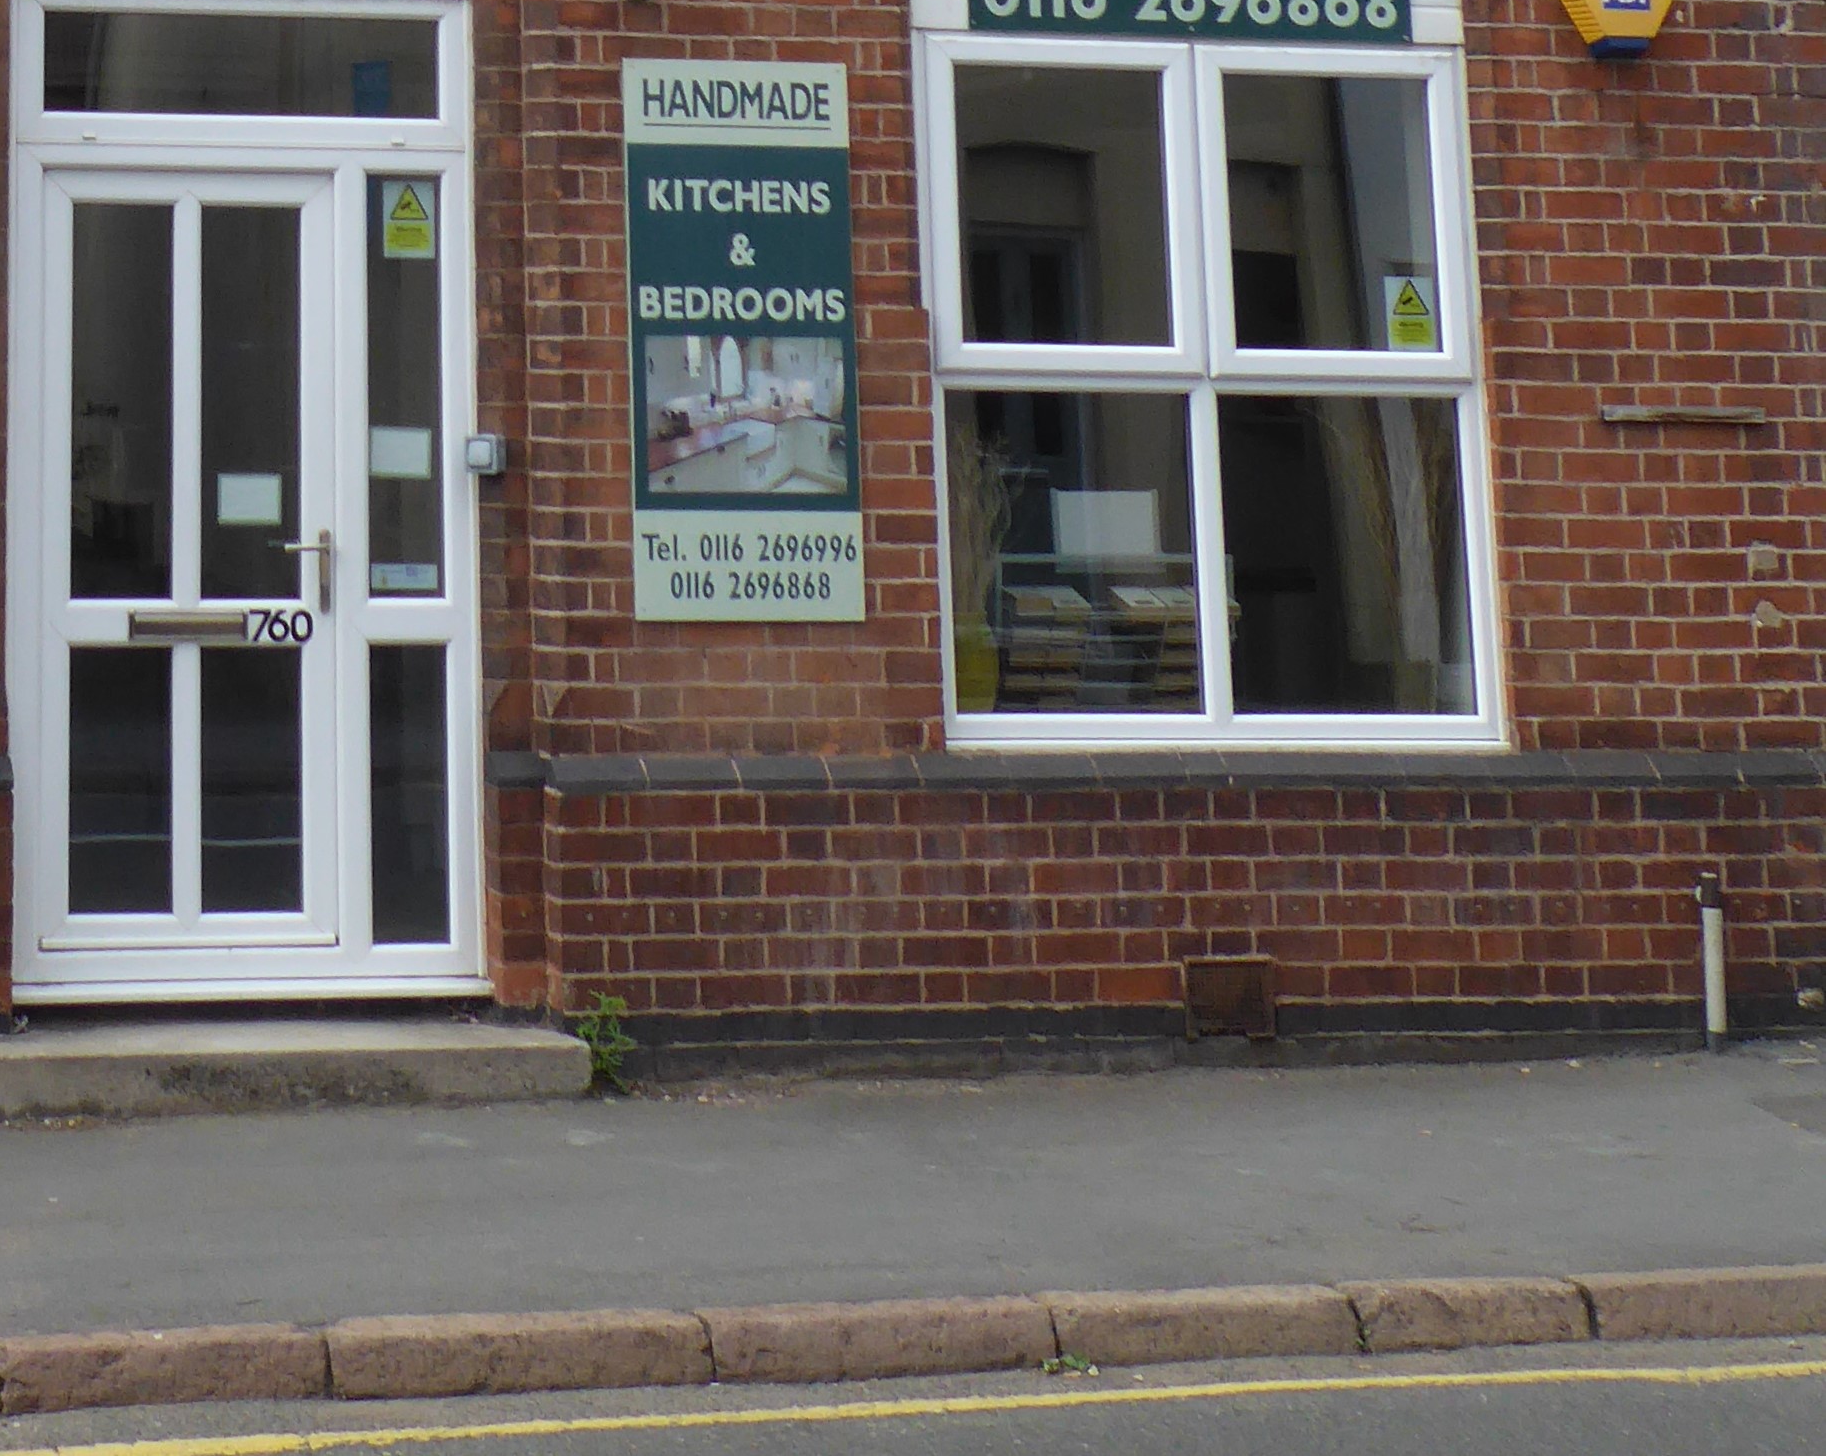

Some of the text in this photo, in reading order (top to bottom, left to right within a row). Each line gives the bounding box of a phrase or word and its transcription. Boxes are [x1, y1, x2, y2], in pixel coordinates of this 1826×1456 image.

[642, 78, 830, 121] HANDMADE
[647, 178, 831, 215] KITCHENS
[729, 232, 756, 266] &
[639, 285, 846, 323] BEDROOMS
[641, 533, 857, 562] Tel. 0116 2696996
[670, 571, 831, 600] 0116 2696868
[249, 609, 313, 642] 760
